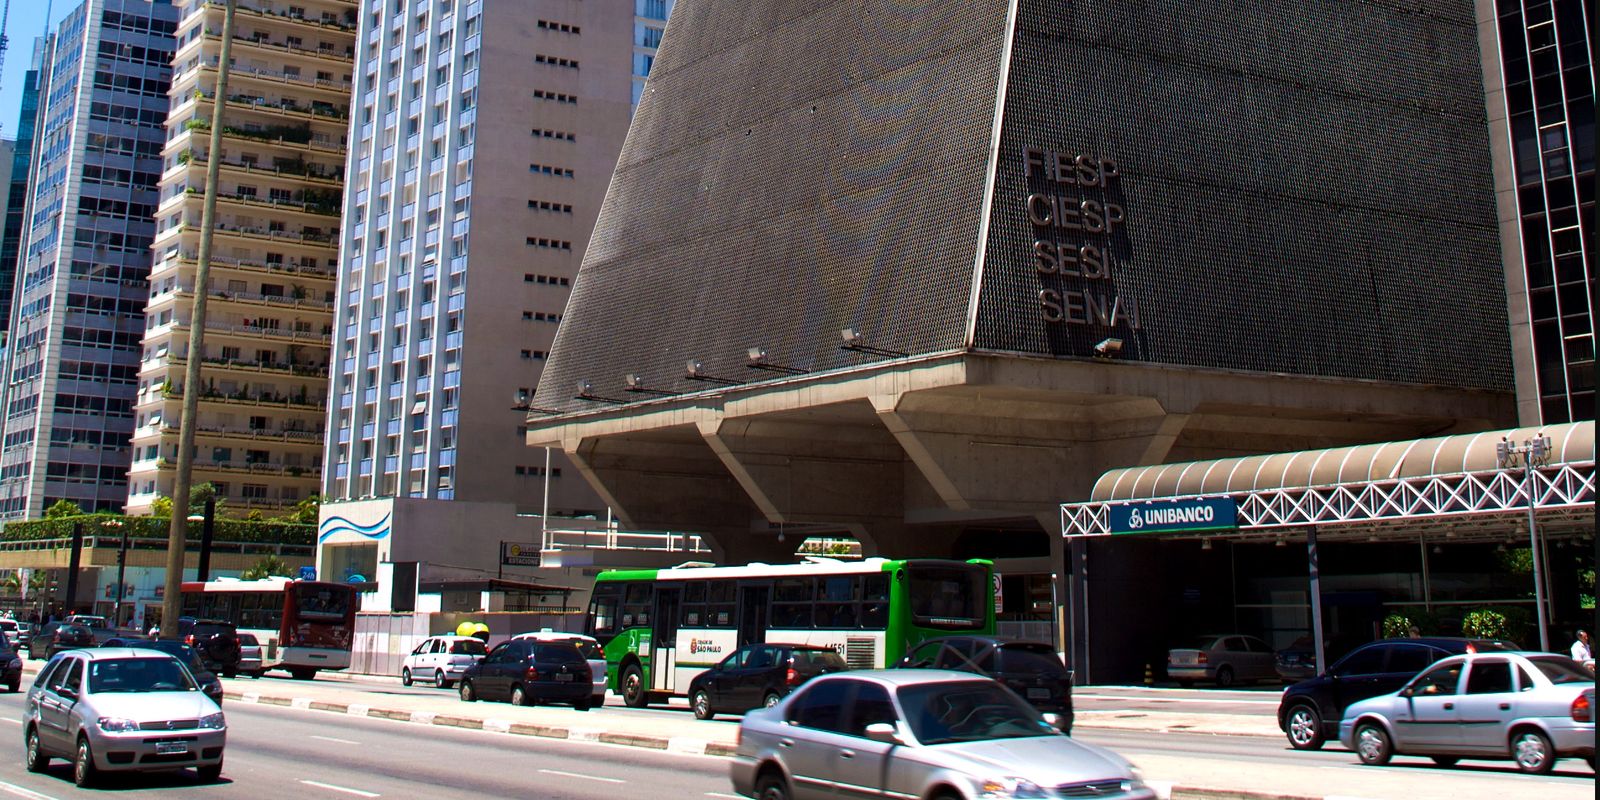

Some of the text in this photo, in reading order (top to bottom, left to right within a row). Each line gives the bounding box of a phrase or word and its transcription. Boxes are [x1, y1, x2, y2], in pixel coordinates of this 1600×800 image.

[1023, 145, 1118, 188] FIESP
[1027, 193, 1124, 234] CIESP
[1034, 240, 1110, 279] SESI
[1039, 288, 1141, 329] SENAI
[1145, 505, 1214, 525] UNIBANCO
